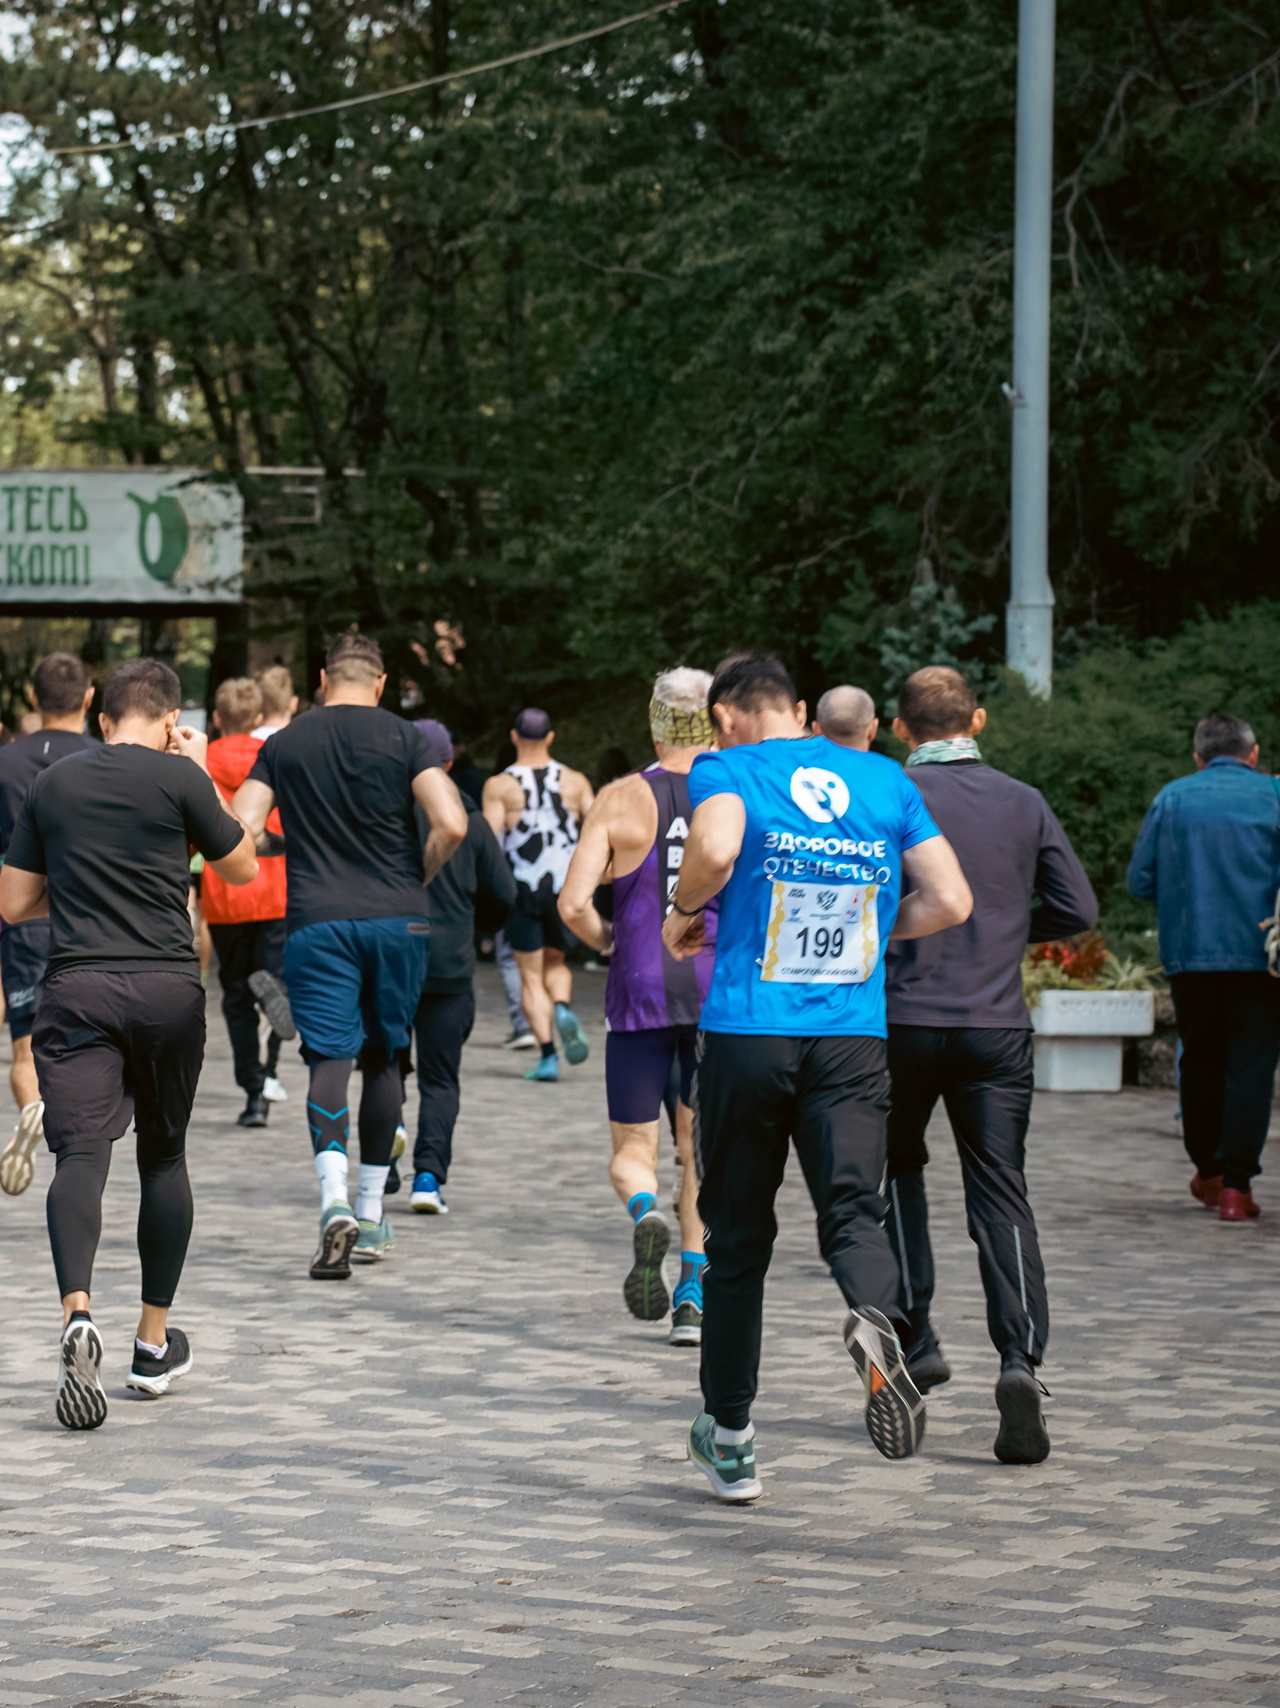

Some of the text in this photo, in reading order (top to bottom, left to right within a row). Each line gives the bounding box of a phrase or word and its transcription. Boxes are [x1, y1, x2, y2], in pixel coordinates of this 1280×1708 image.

[763, 831, 887, 858] ЗДОРОВОЕ
[763, 856, 891, 884] ОТЕЧЕСТВО
[795, 926, 846, 958] 199
